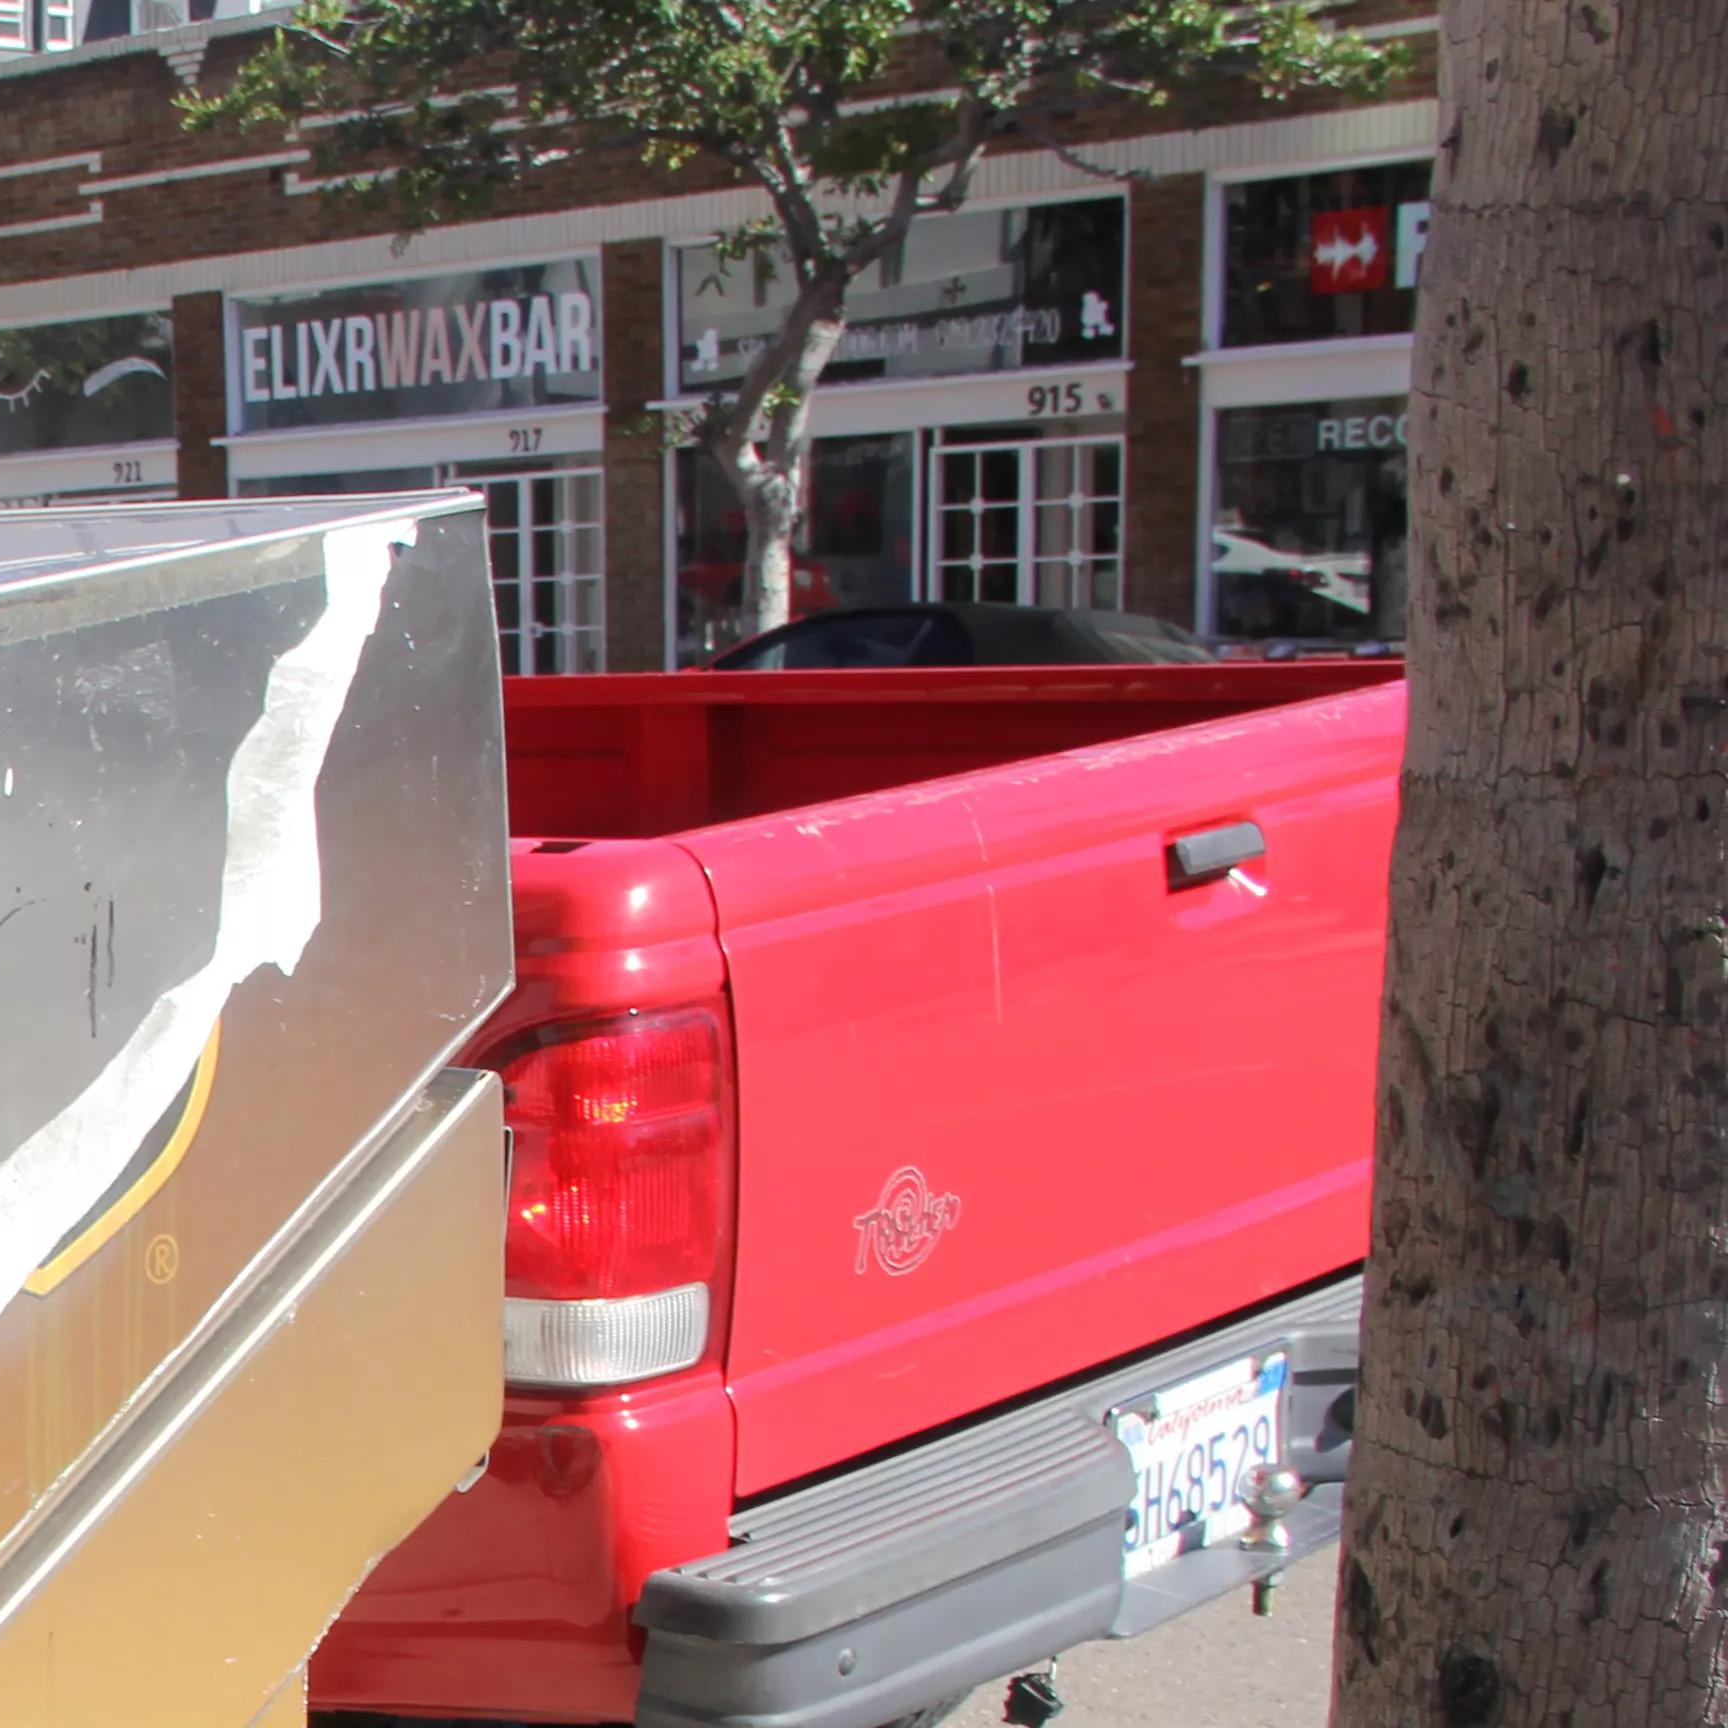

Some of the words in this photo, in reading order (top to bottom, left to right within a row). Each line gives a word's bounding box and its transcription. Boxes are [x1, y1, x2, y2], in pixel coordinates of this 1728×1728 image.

[1028, 382, 1082, 416] 915
[508, 427, 543, 453] 917
[113, 460, 143, 484] 921
[1148, 1387, 1248, 1446] California
